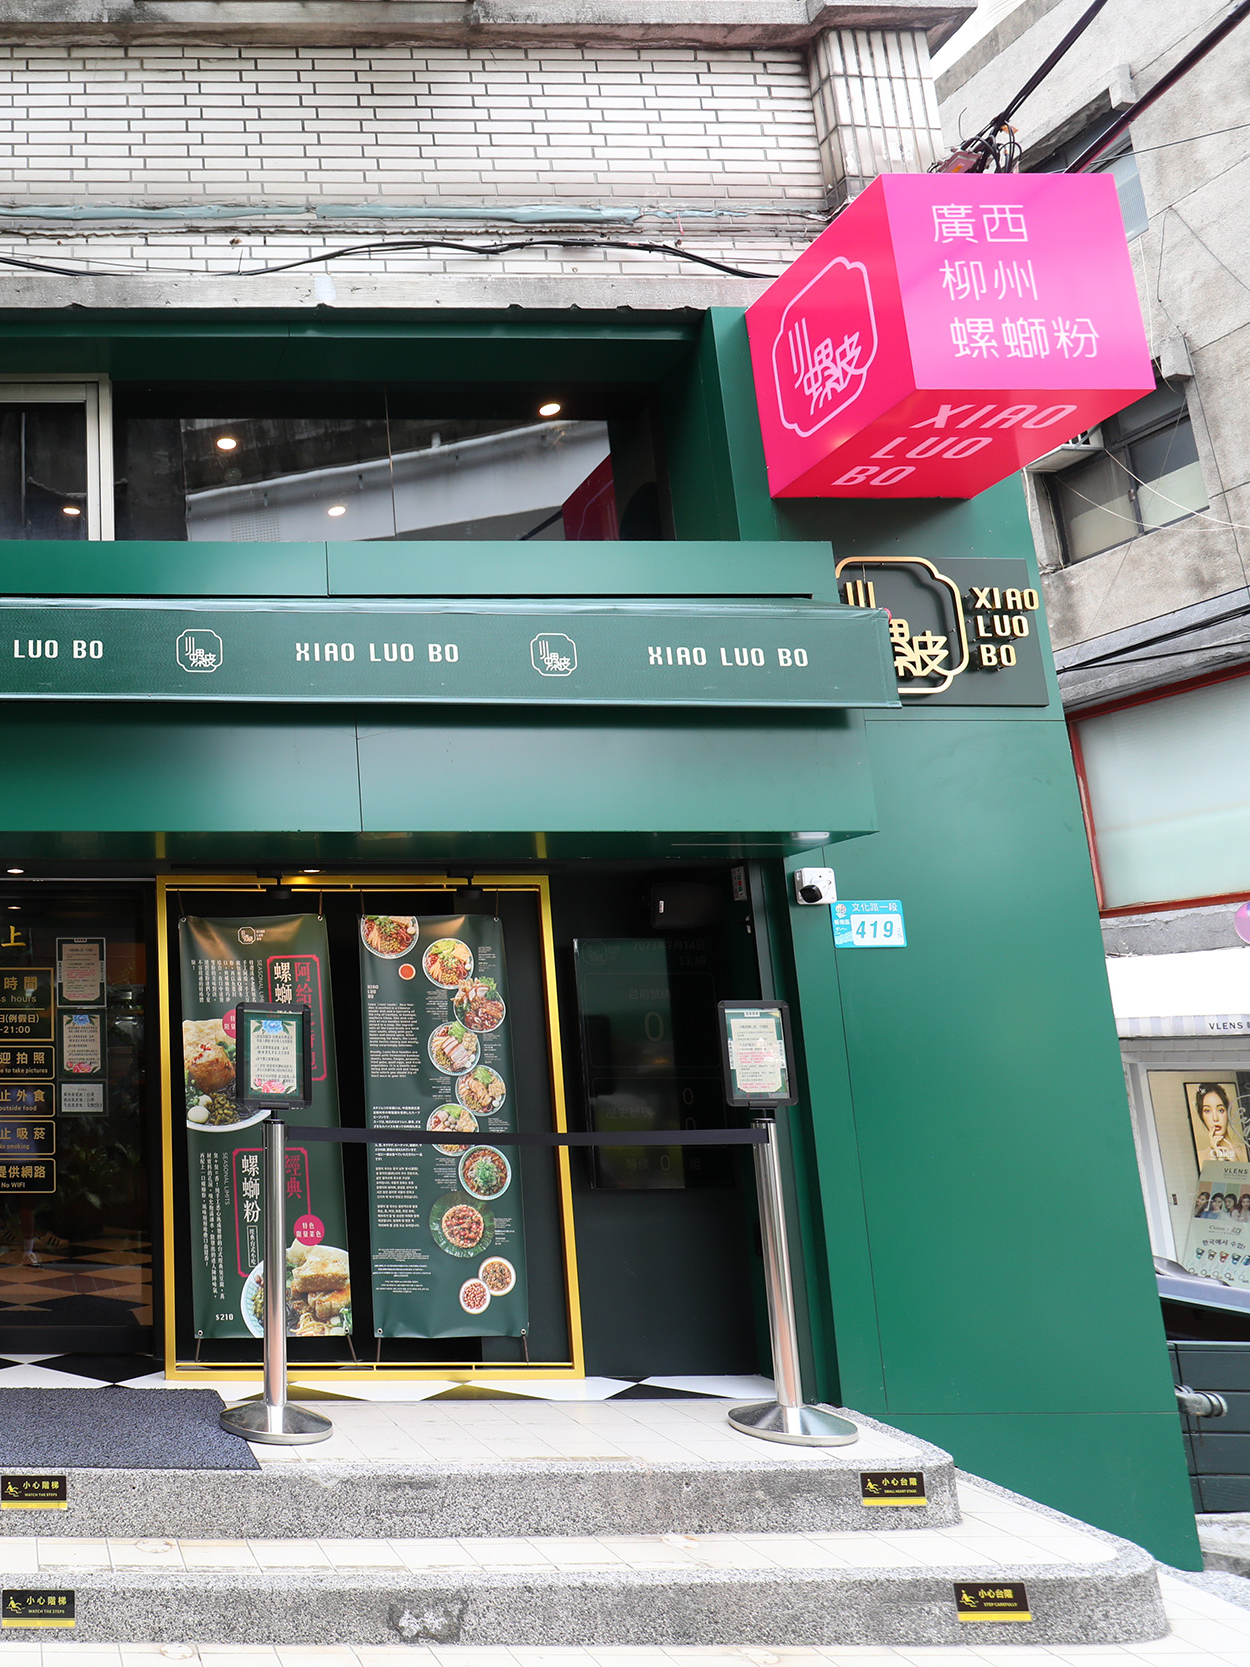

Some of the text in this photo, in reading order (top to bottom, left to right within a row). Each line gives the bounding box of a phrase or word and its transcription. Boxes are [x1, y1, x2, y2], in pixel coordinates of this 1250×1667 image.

[931, 203, 1029, 244] 廣西
[939, 259, 1039, 301] 柳州
[949, 316, 1100, 360] 螺螄粉
[909, 404, 1078, 429] XIAO
[869, 436, 993, 459] LUO
[831, 465, 916, 486] BO
[969, 586, 1040, 611] XIAO
[976, 615, 1030, 638] LUO
[13, 639, 59, 659] LUO
[73, 640, 104, 660] BO
[295, 642, 460, 663] XIAO LUO BO
[648, 646, 809, 668] XIAO LUO BO
[980, 643, 1017, 667] BO
[851, 902, 899, 912] 文化路一段
[856, 920, 894, 939] 419
[10, 995, 37, 1003] hours
[1209, 1022, 1243, 1030] VLENS
[25, 1067, 48, 1075] pictures
[285, 1155, 302, 1199] 經典
[1223, 1167, 1248, 1175] VLENS
[241, 1154, 261, 1223] 螺螄粉
[215, 1313, 234, 1321] $210
[22, 1481, 60, 1490] 小心階梯
[881, 1477, 918, 1486] 小心台階
[26, 1596, 67, 1606] 小心階梯
[978, 1588, 1014, 1599] 小心台階
